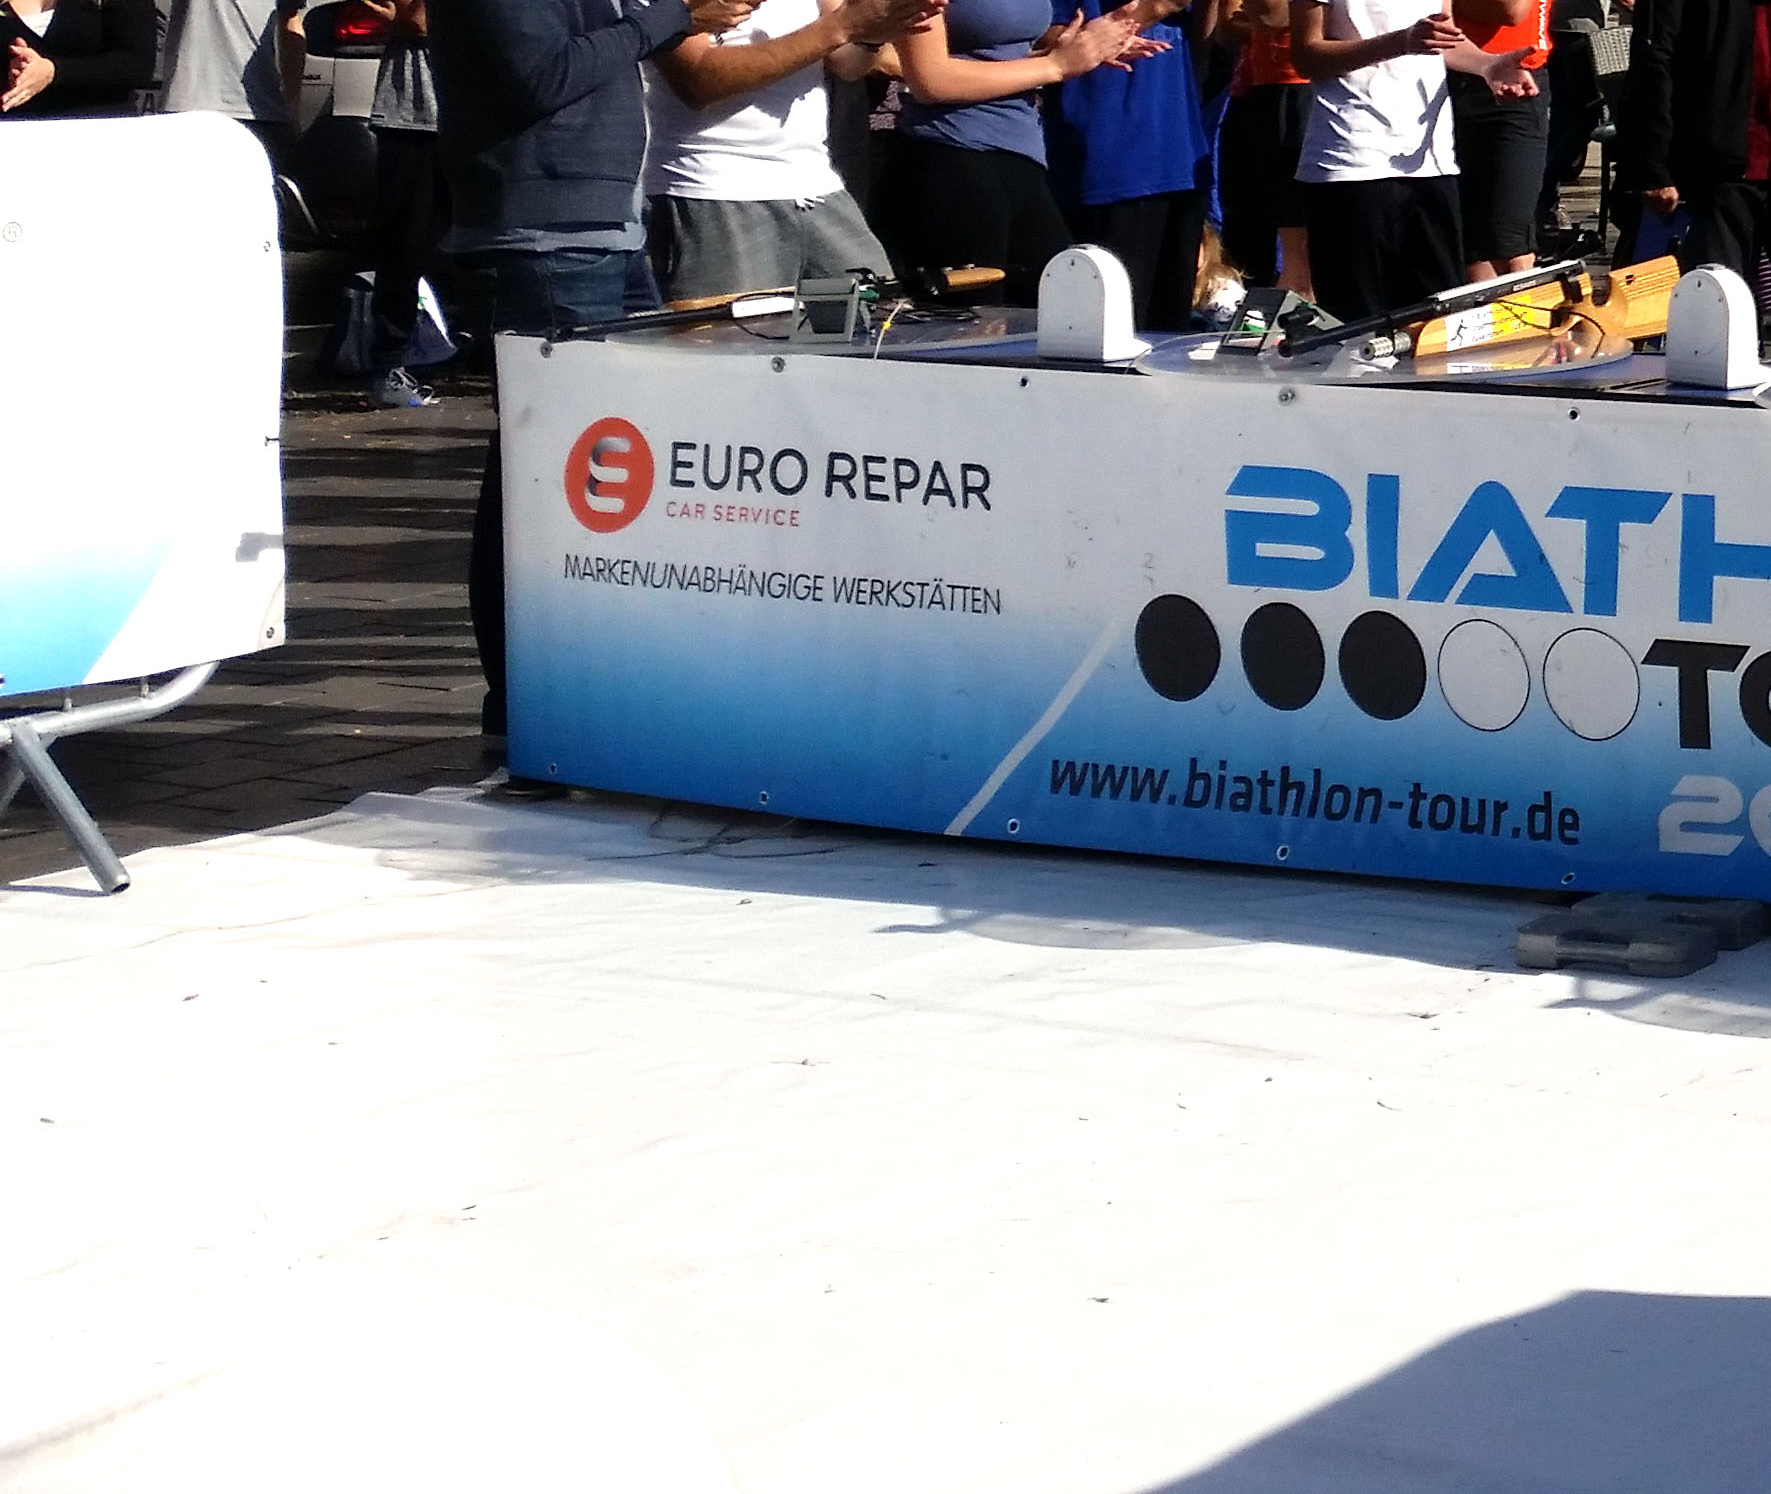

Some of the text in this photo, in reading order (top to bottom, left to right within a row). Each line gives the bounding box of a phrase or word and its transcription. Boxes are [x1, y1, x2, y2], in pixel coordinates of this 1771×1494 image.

[668, 440, 992, 512] EURO REPAR
[665, 501, 801, 528] CAR SERVICE
[563, 552, 1002, 616] MARKENUNABHÄNGIGE WERKSTÄTTEN
[1048, 755, 1583, 848] www.biathlon-tour.de
